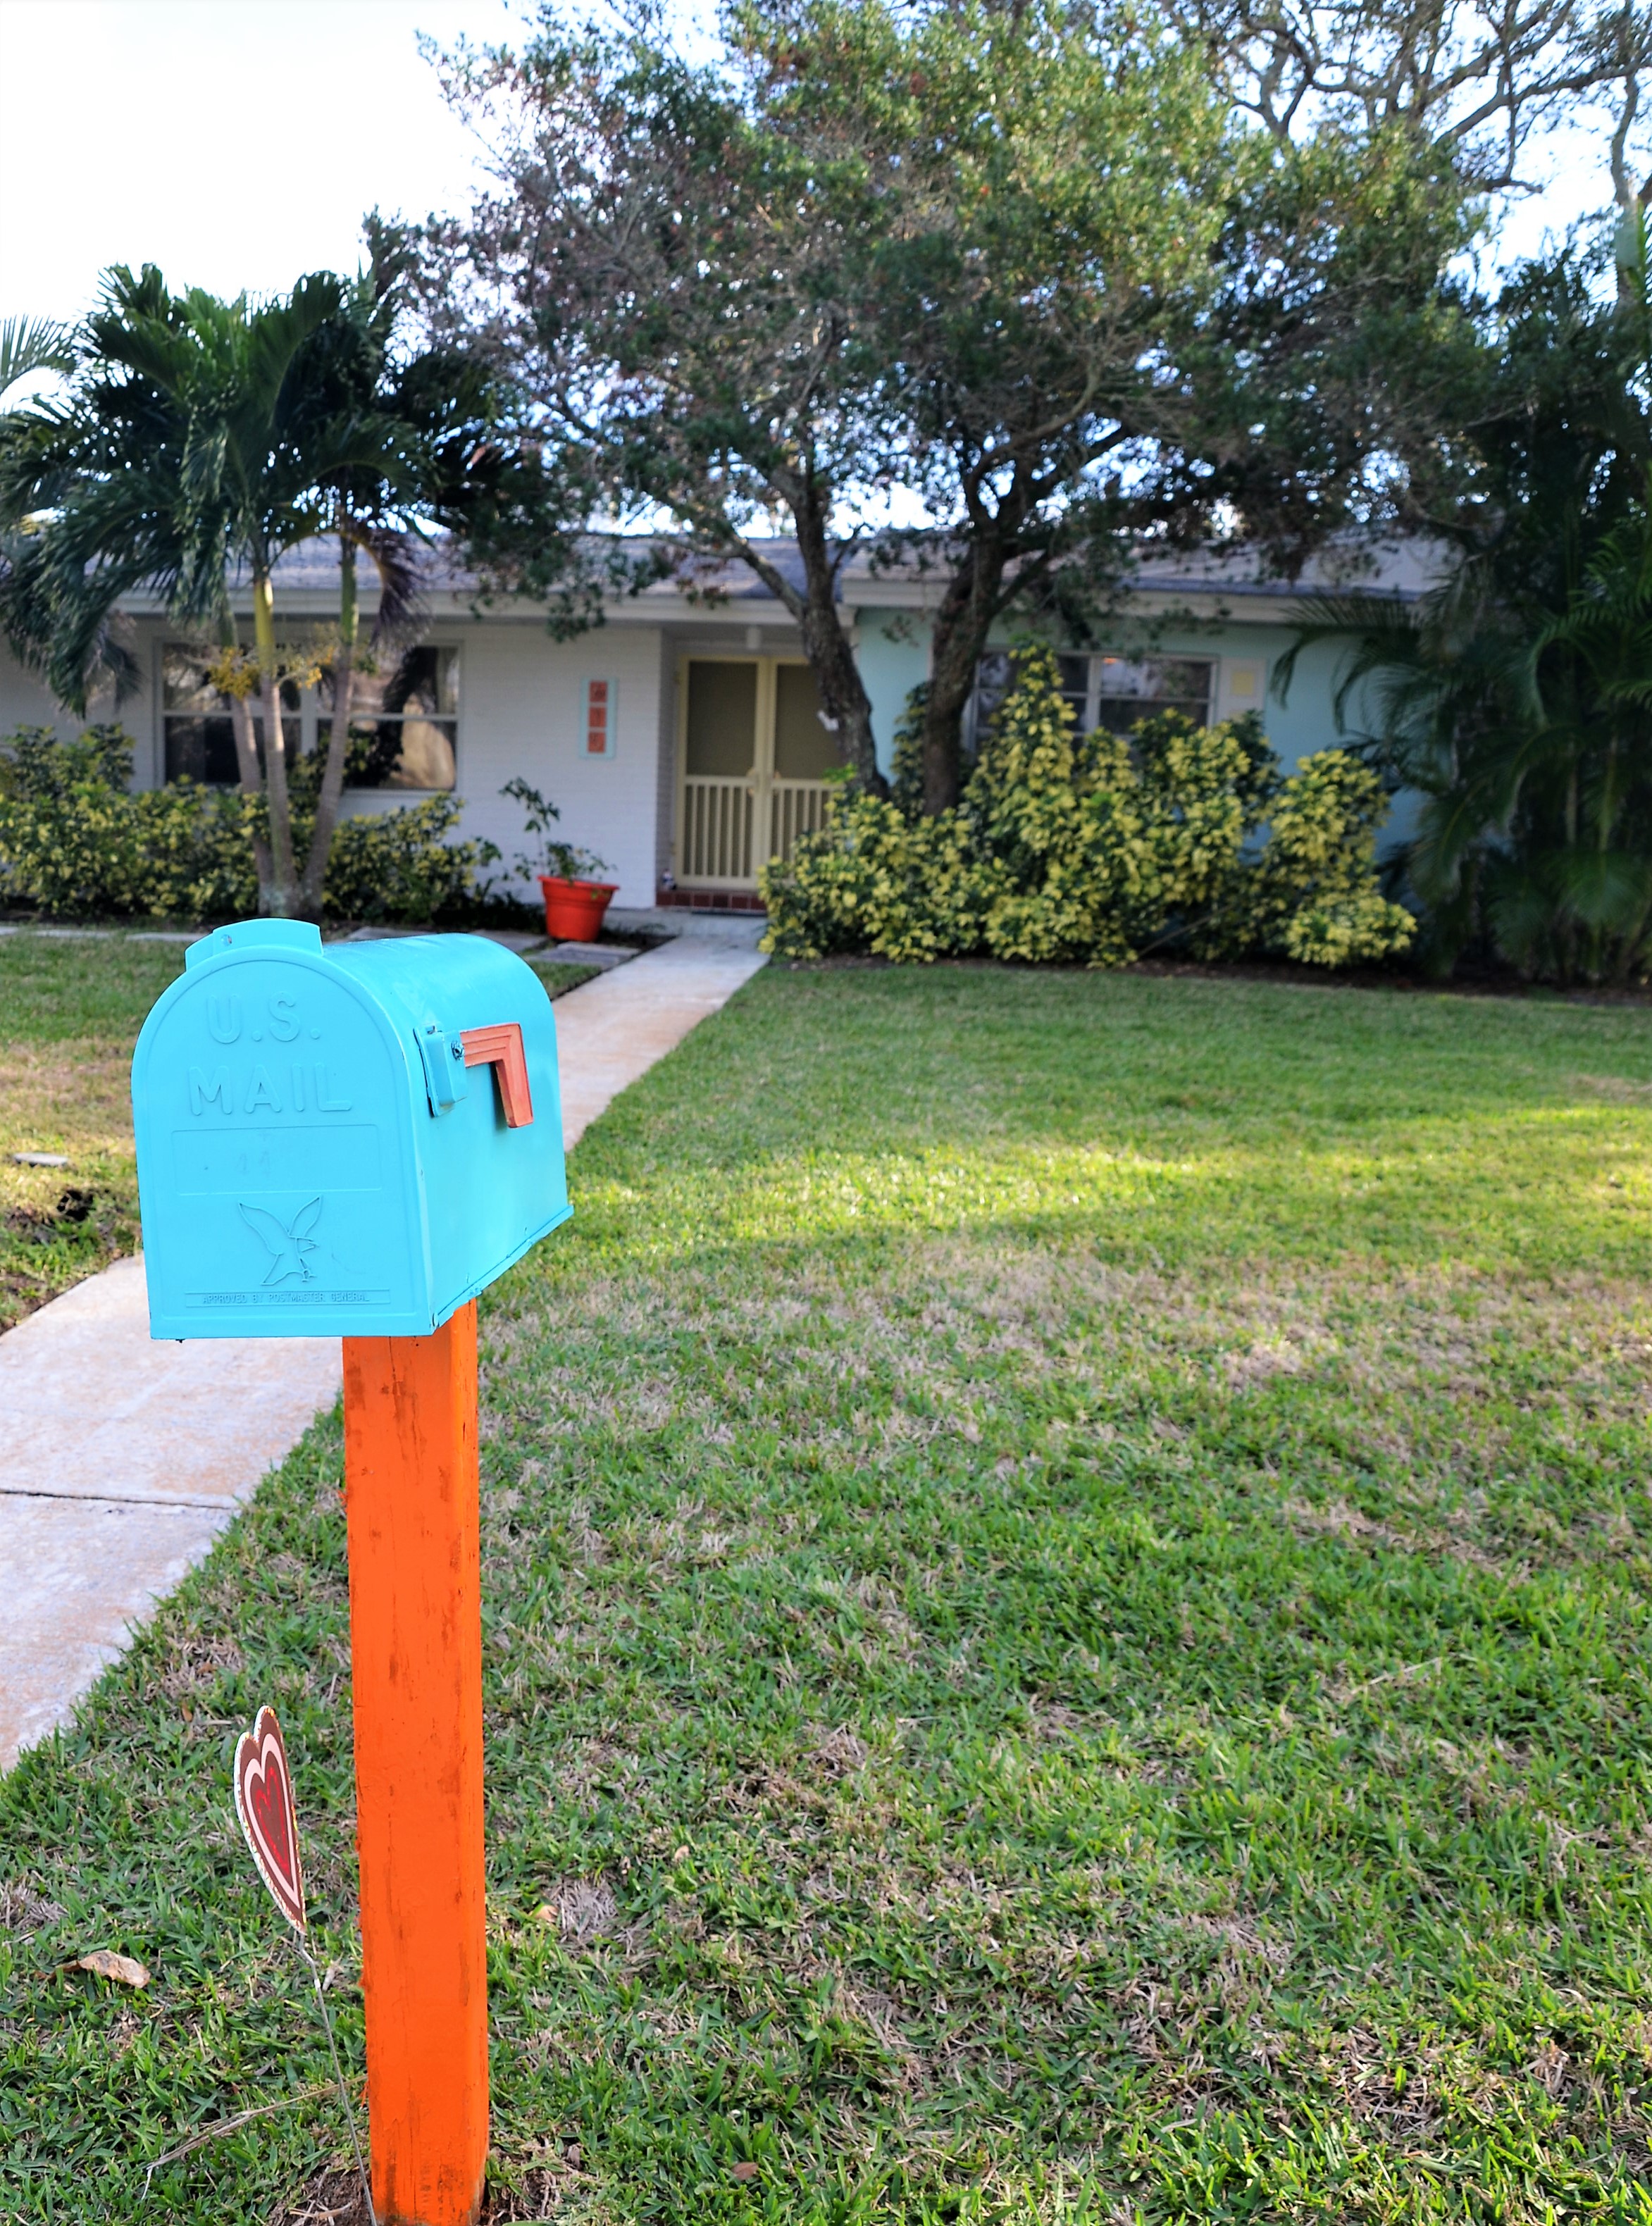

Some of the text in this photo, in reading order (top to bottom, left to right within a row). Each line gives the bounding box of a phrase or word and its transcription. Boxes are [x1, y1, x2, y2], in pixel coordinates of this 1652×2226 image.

[206, 991, 321, 1045] U.S.
[187, 1062, 352, 1117] MAIL
[202, 1292, 371, 1305] APPROVED BY POSTMASTER GENERAL
